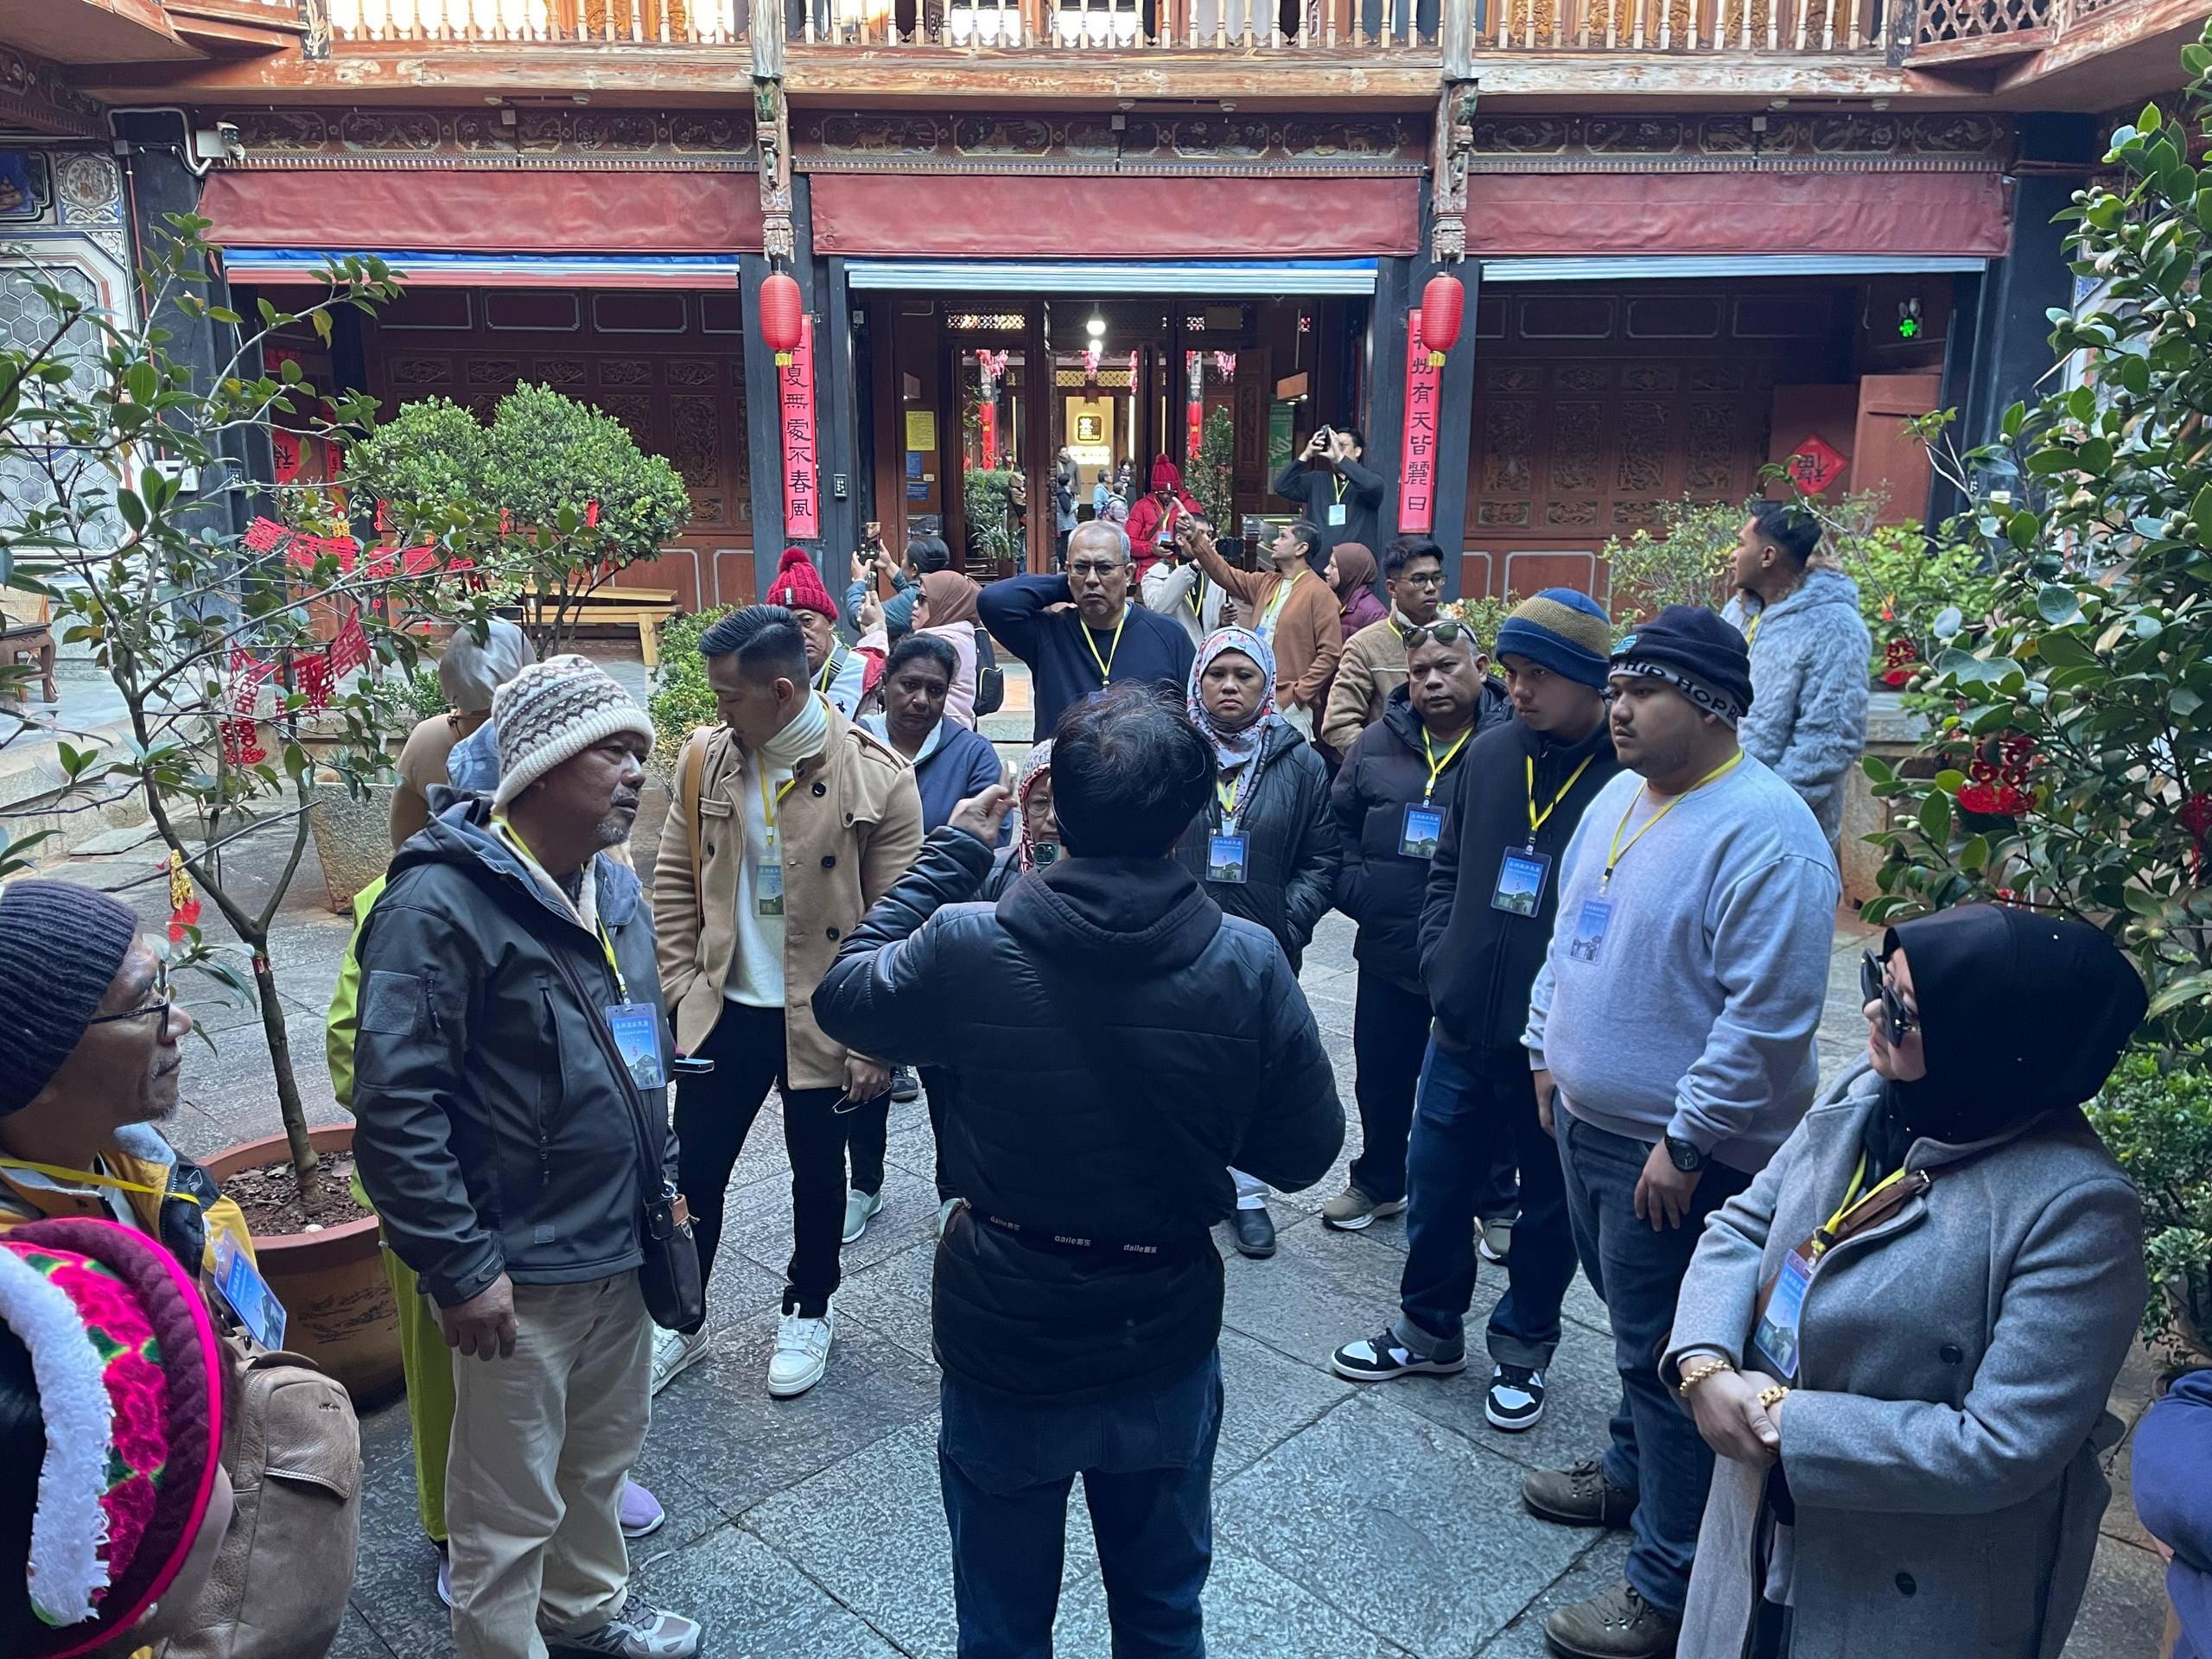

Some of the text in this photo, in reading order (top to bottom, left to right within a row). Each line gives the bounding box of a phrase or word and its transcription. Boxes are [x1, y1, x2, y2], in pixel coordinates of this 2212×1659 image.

[1798, 454, 1830, 485] 福
[1624, 659, 1666, 678] HIP
[1676, 675, 1726, 712] HOP
